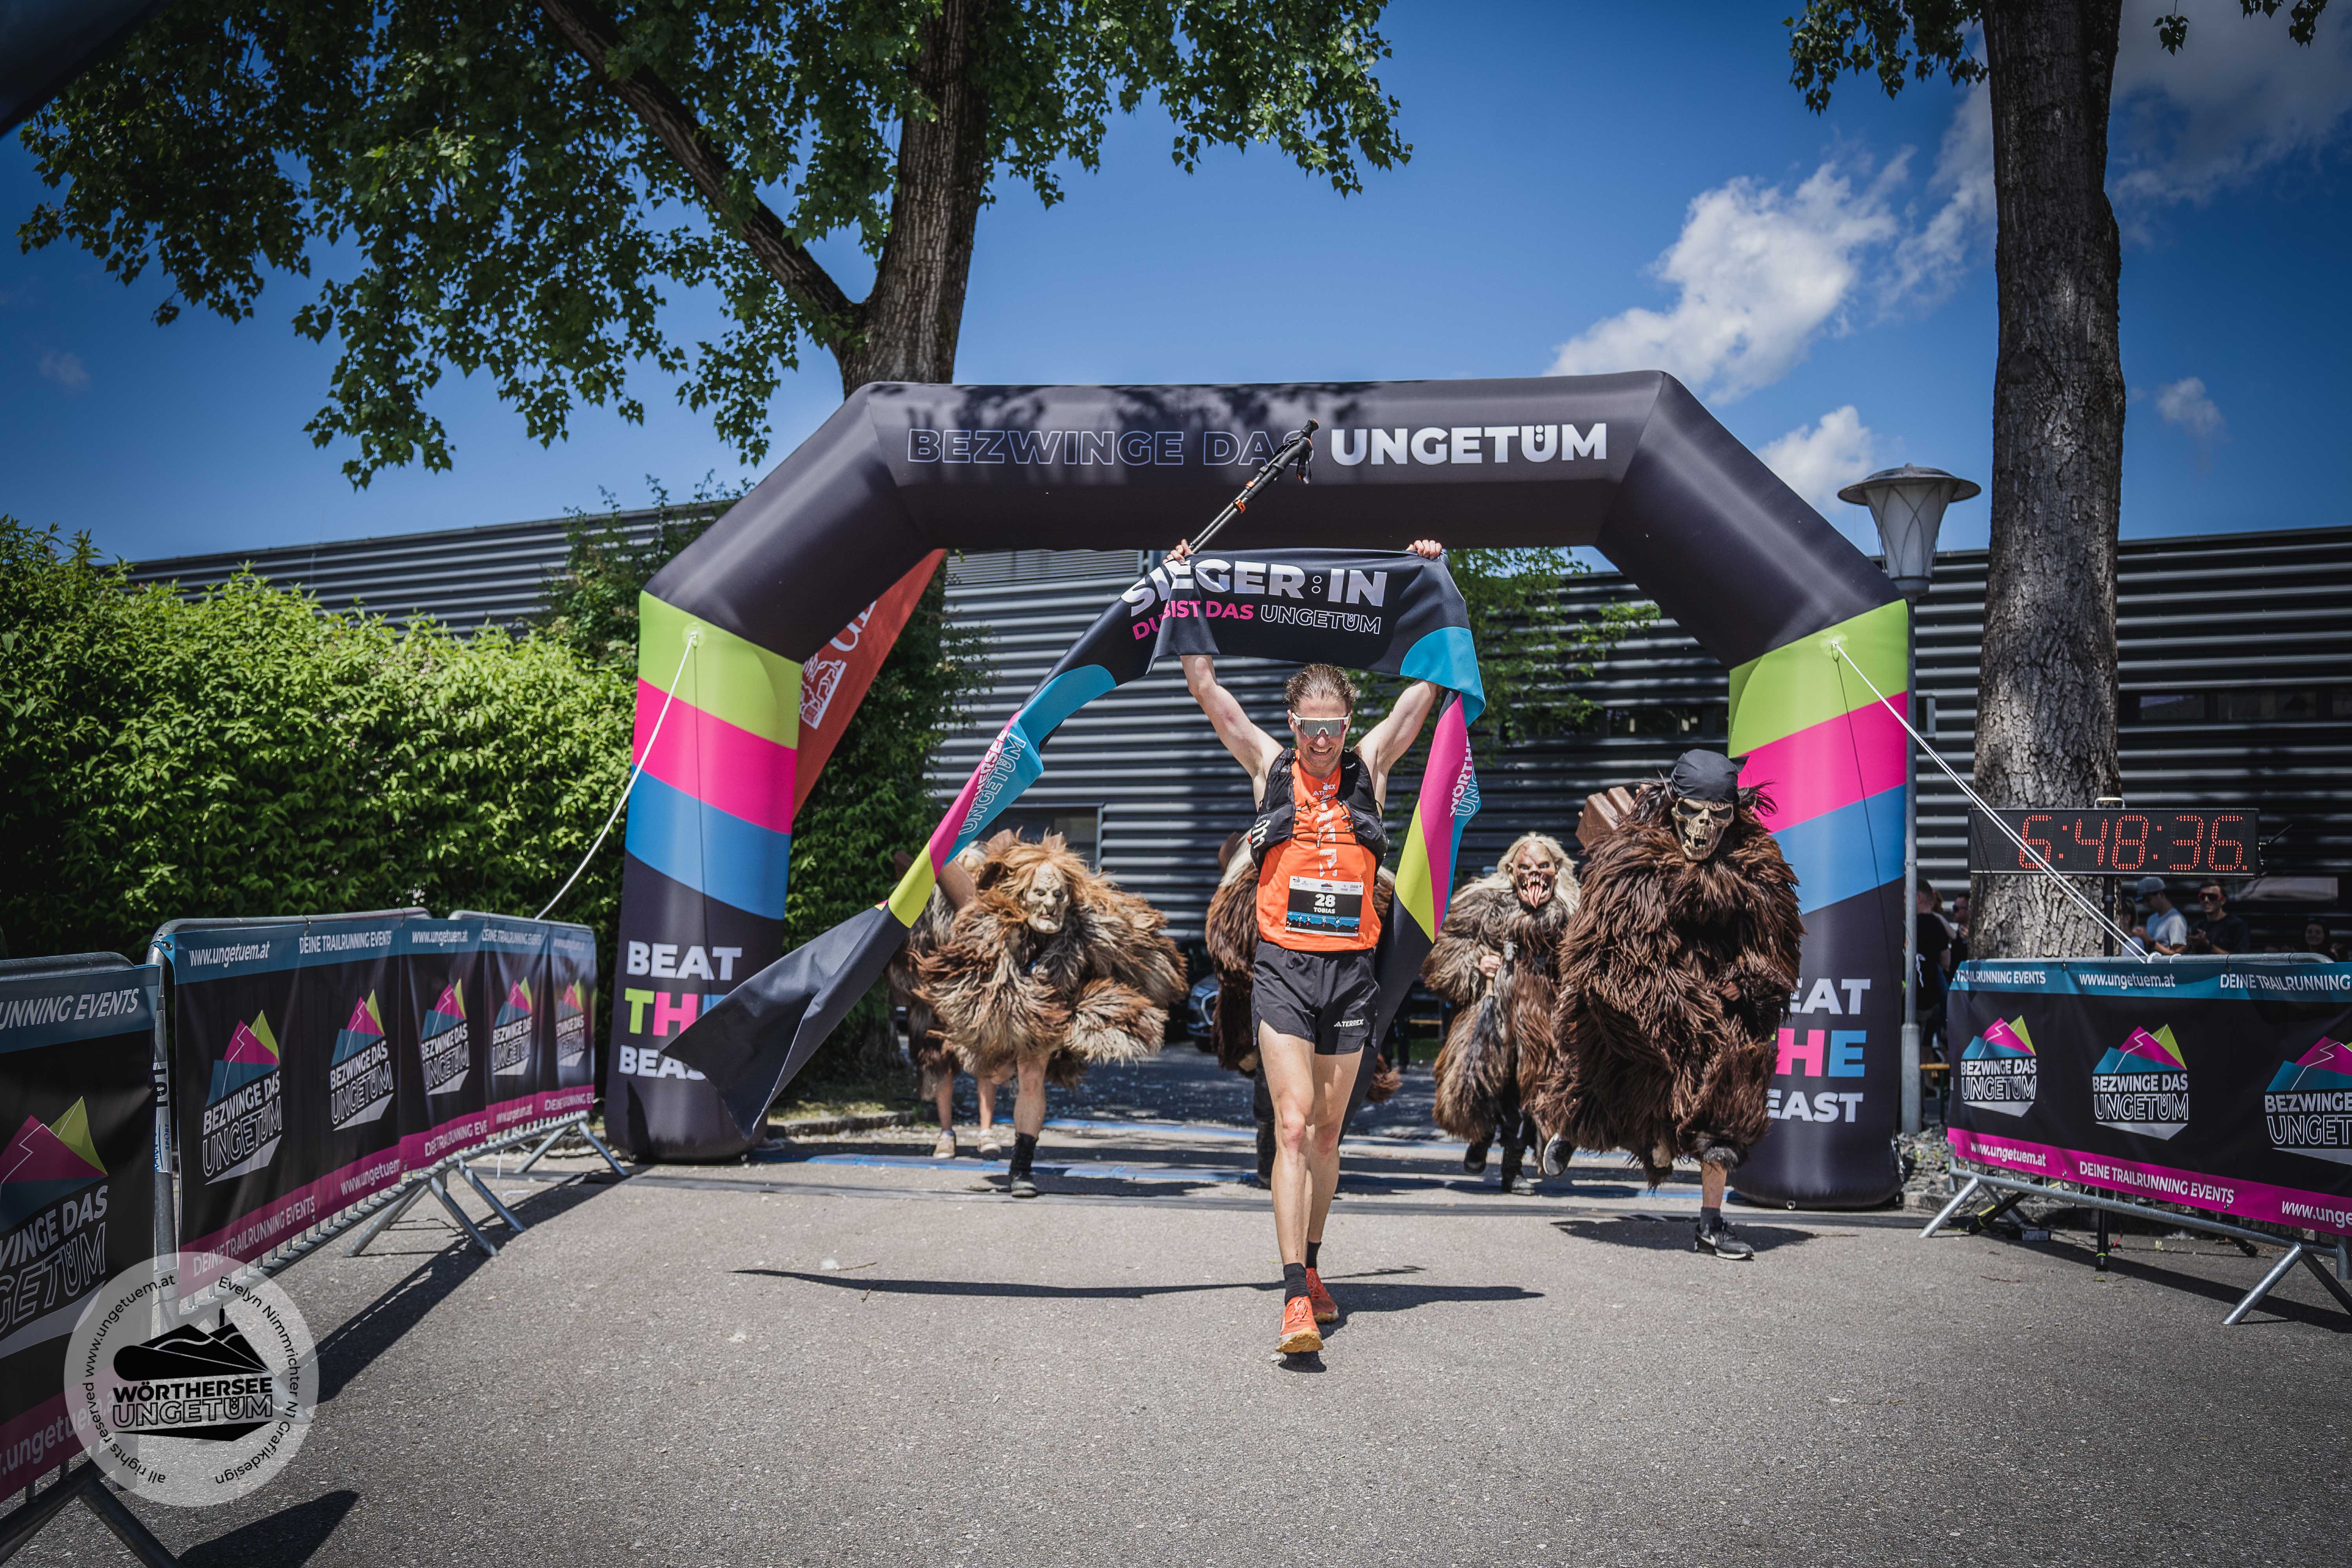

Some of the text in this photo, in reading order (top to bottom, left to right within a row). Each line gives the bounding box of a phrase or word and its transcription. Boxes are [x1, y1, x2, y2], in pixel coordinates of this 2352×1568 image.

[907, 428, 1184, 466] BEZWINGE
[1330, 422, 1606, 465] UNGETÜM
[1206, 601, 1254, 620] DAS
[1261, 604, 1382, 635] UNGETÜM
[958, 732, 1027, 835] UNGETÜM
[1315, 893, 1336, 907] 28
[299, 929, 392, 954] DEINE TRAILRUNNING EVENTS
[412, 929, 468, 946] www.ungetuem.at
[189, 940, 270, 968] www.ungetuem.at
[627, 940, 742, 981] BEAT
[1956, 969, 2046, 984] TRAILRUNNING EVENTS
[2079, 973, 2176, 990] www.ungetuem.at
[2220, 974, 2351, 991] DEINE TRAILRUNNING
[74, 988, 139, 1020] EVENTS
[1341, 1018, 1364, 1027] TERREX
[421, 1023, 468, 1061] BEZWINGE DAS
[1771, 1028, 1867, 1078] HE
[330, 1040, 388, 1091] BEZWINGE DAS
[1961, 1058, 2037, 1076] BEZWINGE DAS
[1961, 1075, 2037, 1100] UNGETÜM
[2092, 1073, 2189, 1092] BEZWINGE DAS
[203, 1082, 263, 1136] BEZWINGE
[264, 1070, 280, 1101] DAS
[1766, 1088, 1864, 1123] EAST
[2094, 1093, 2189, 1121] UNGETÜM
[2265, 1092, 2352, 1113] BEZWINGE
[203, 1095, 282, 1177] UNGETÜM
[1970, 1142, 2046, 1167] www.ungetuem.at
[2080, 1161, 2234, 1204] DEINE TRAILRUNNING EVENTS
[63, 1185, 108, 1236] DAS
[193, 1194, 316, 1277] DEINE TRAILRUNNING EVENTS
